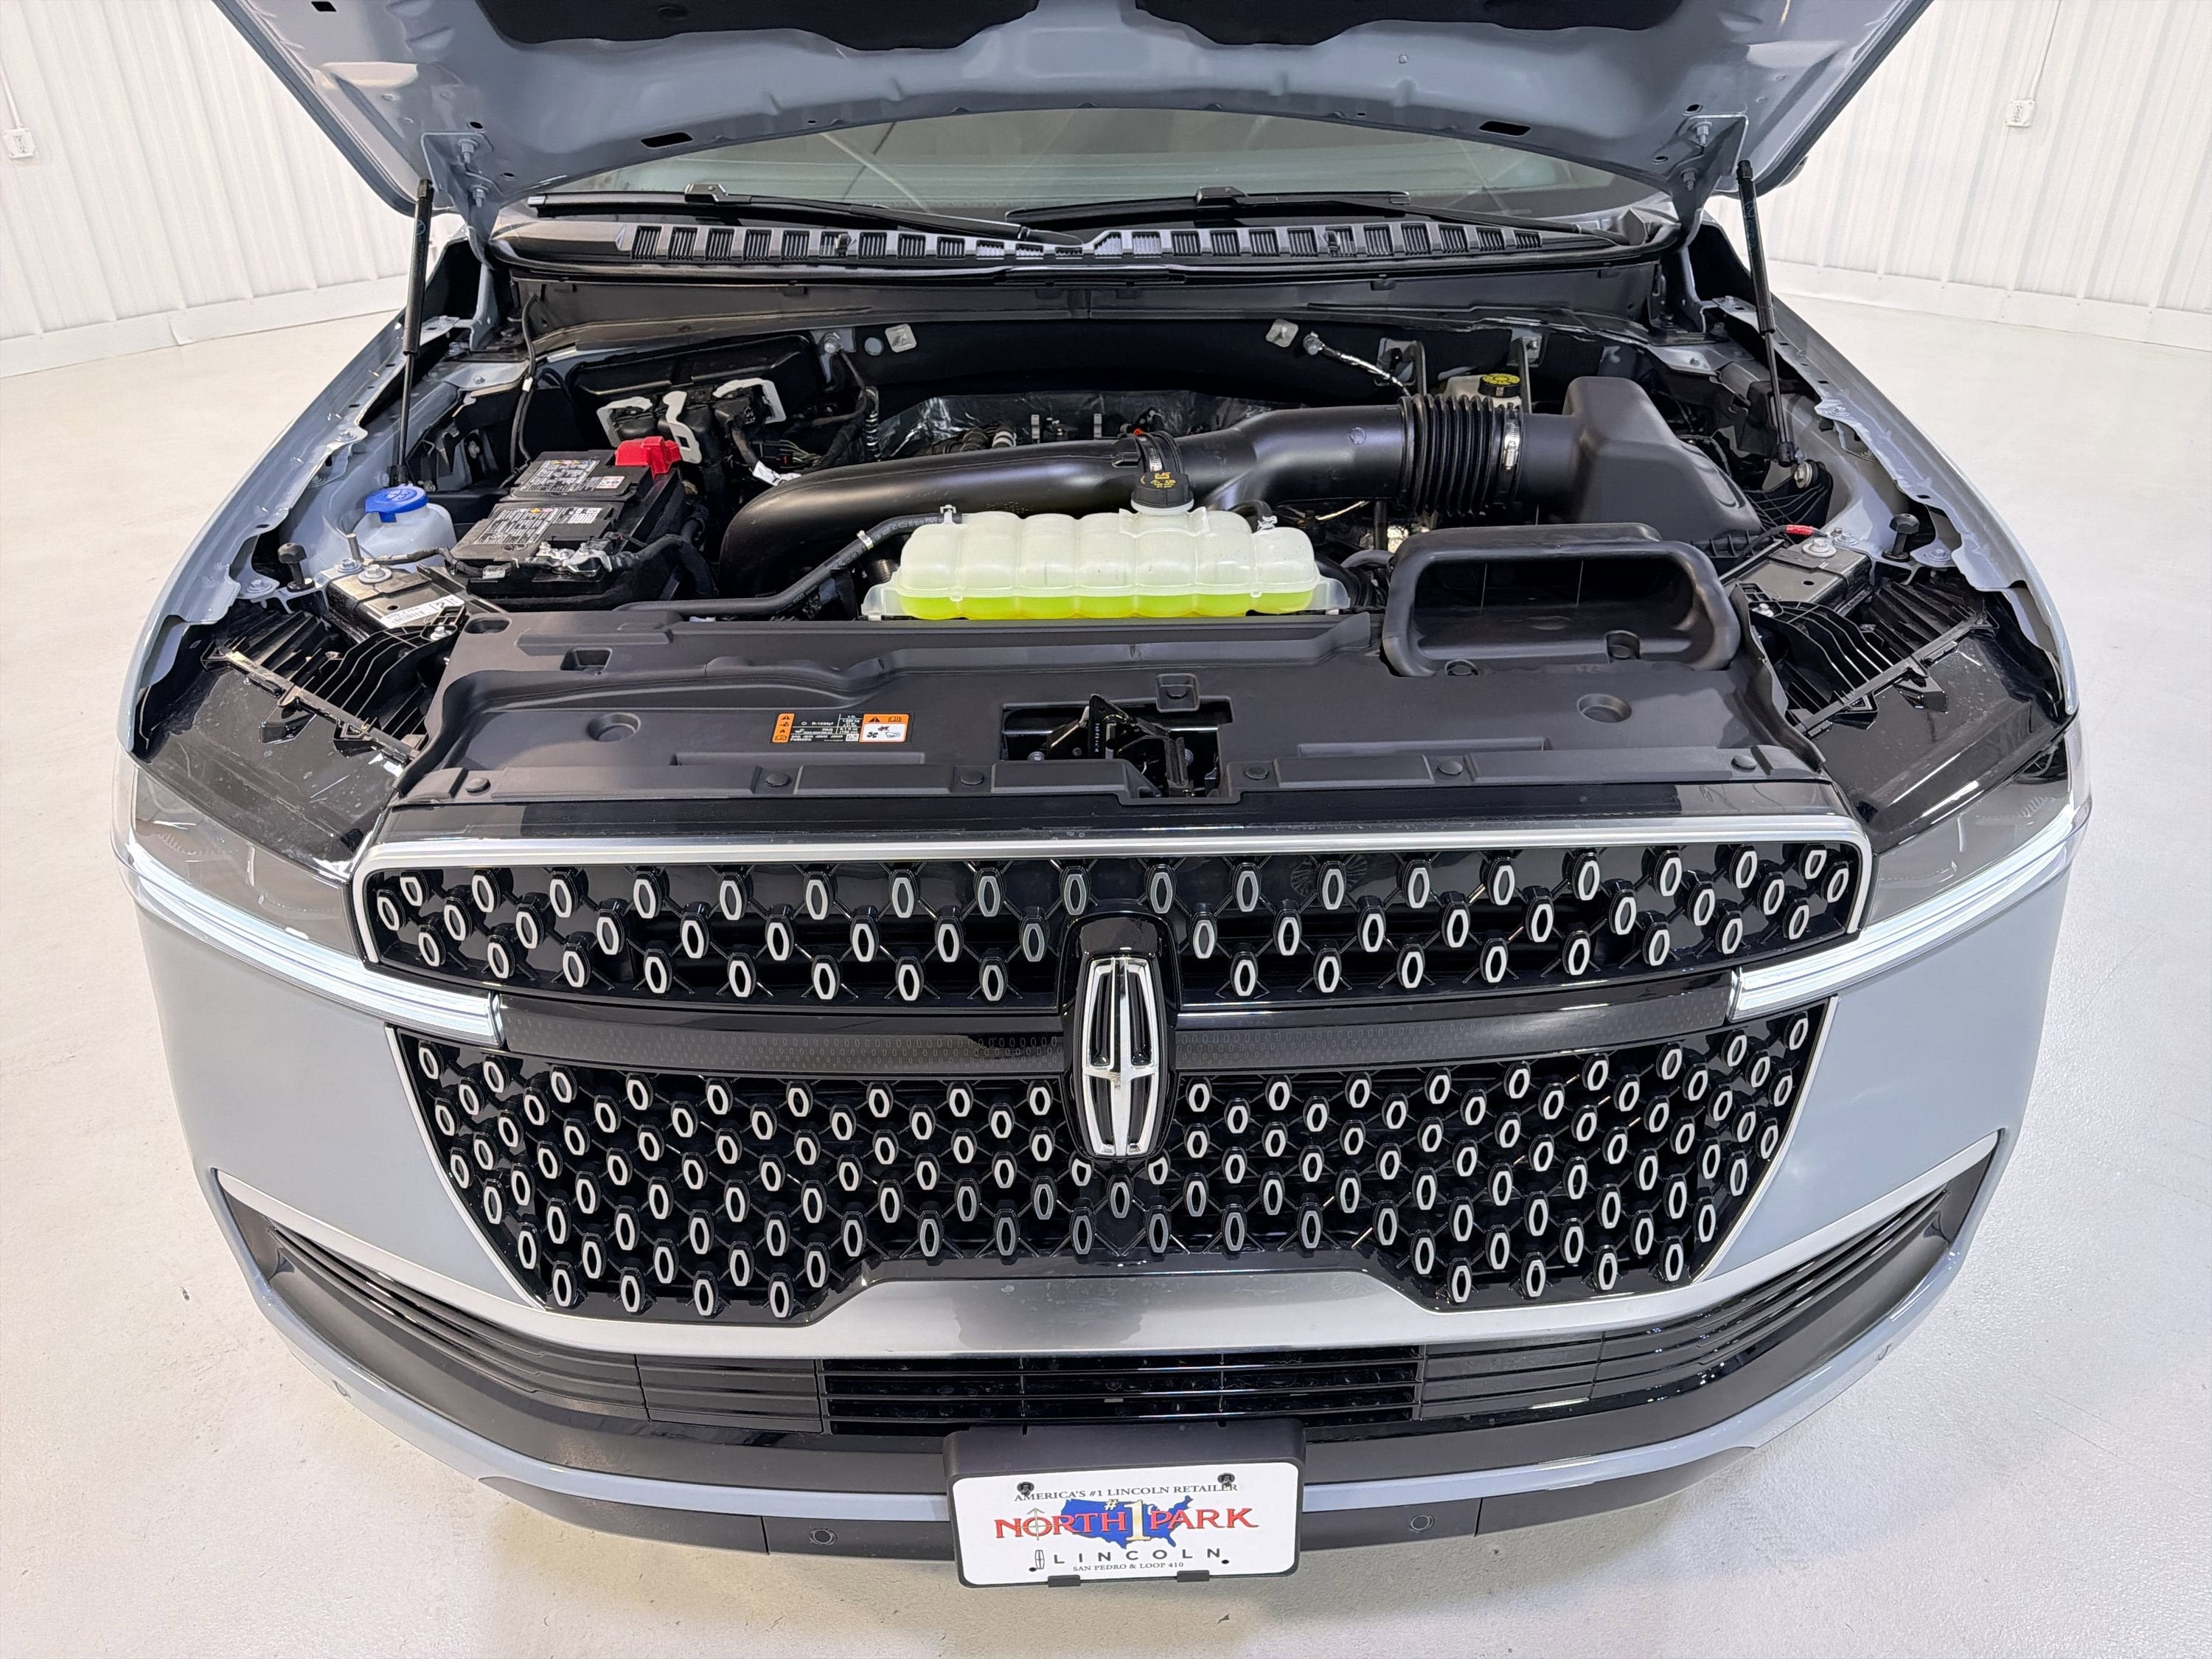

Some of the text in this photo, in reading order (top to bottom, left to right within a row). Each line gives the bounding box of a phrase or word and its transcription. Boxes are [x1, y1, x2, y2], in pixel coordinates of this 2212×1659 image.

[1014, 1489, 1086, 1502] AMERICA'S
[1107, 1486, 1170, 1496] LINCOLN
[1173, 1484, 1239, 1493] RETAILER
[993, 1507, 1260, 1539] NORTH PARK
[1054, 1548, 1220, 1564] LINCOLN
